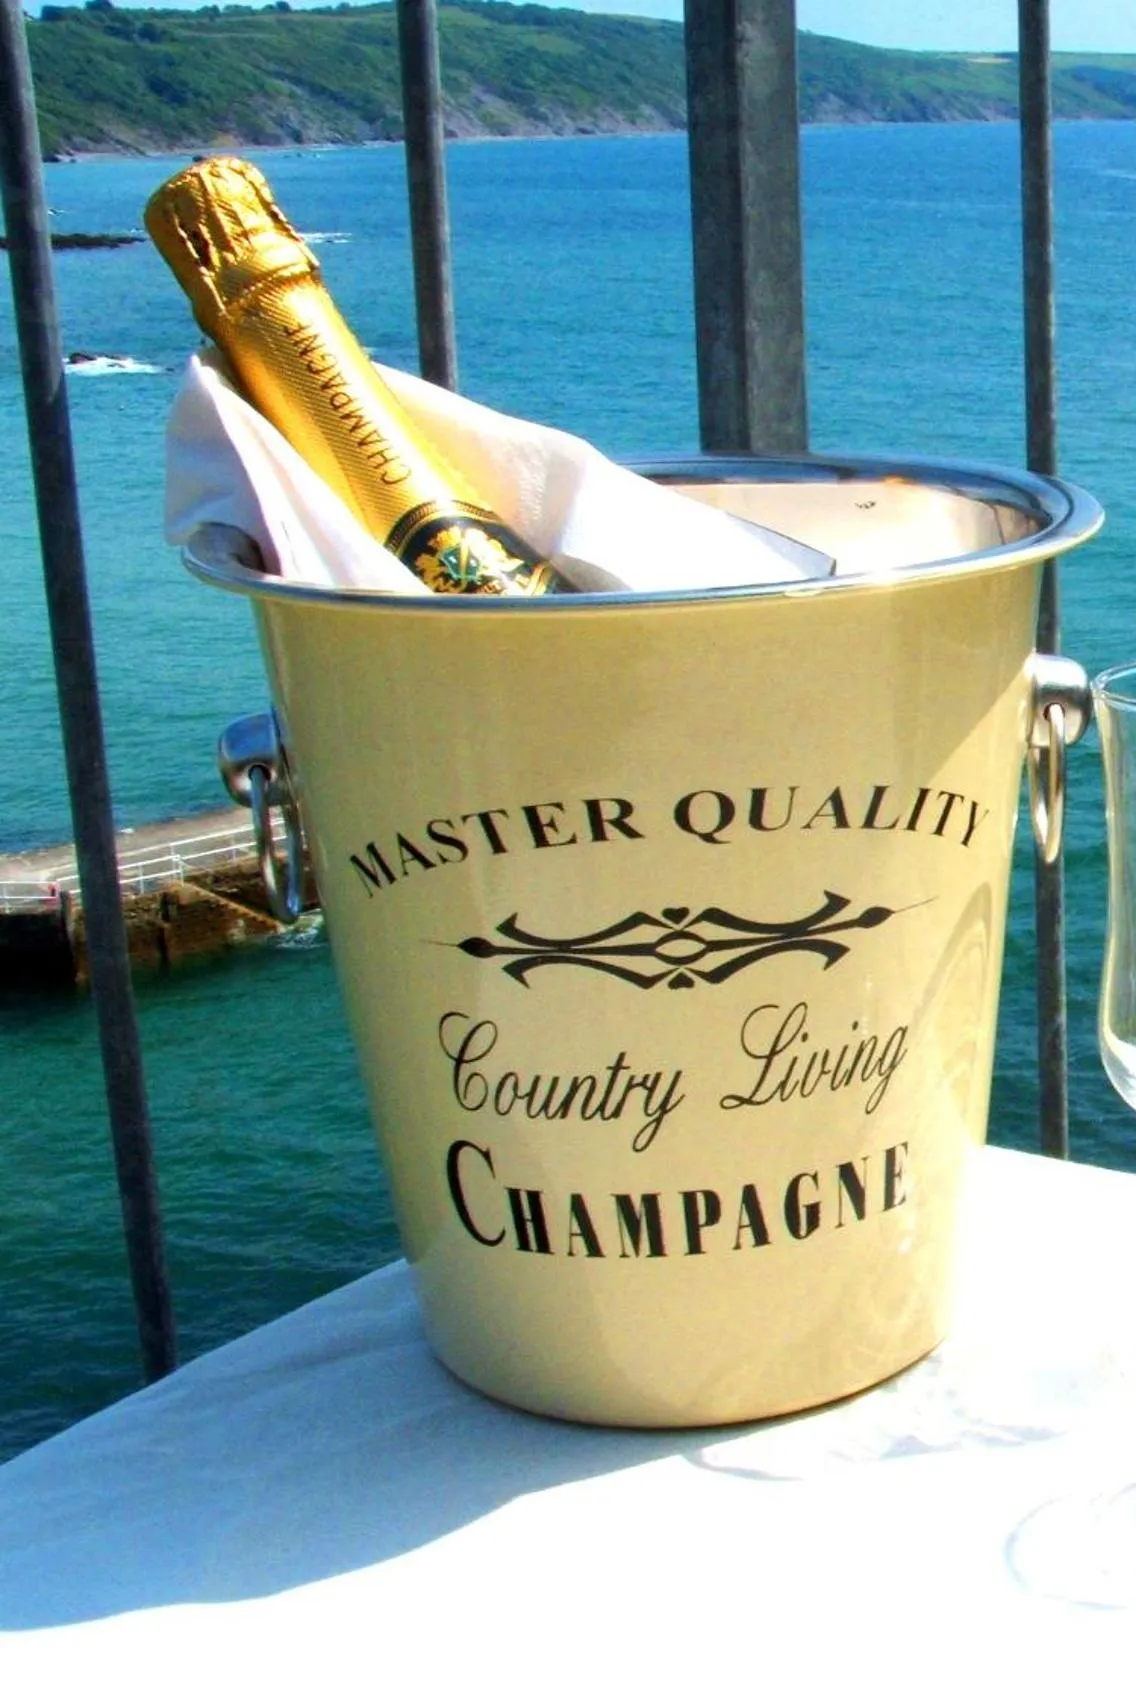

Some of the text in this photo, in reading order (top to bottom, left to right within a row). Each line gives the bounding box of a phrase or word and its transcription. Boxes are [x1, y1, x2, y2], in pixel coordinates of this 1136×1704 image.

[283, 319, 412, 485] CHAMPAGNE
[348, 785, 989, 899] MASTER QUALITY
[438, 1001, 909, 1153] Country Living
[445, 1139, 910, 1259] CHAMPAGNE
